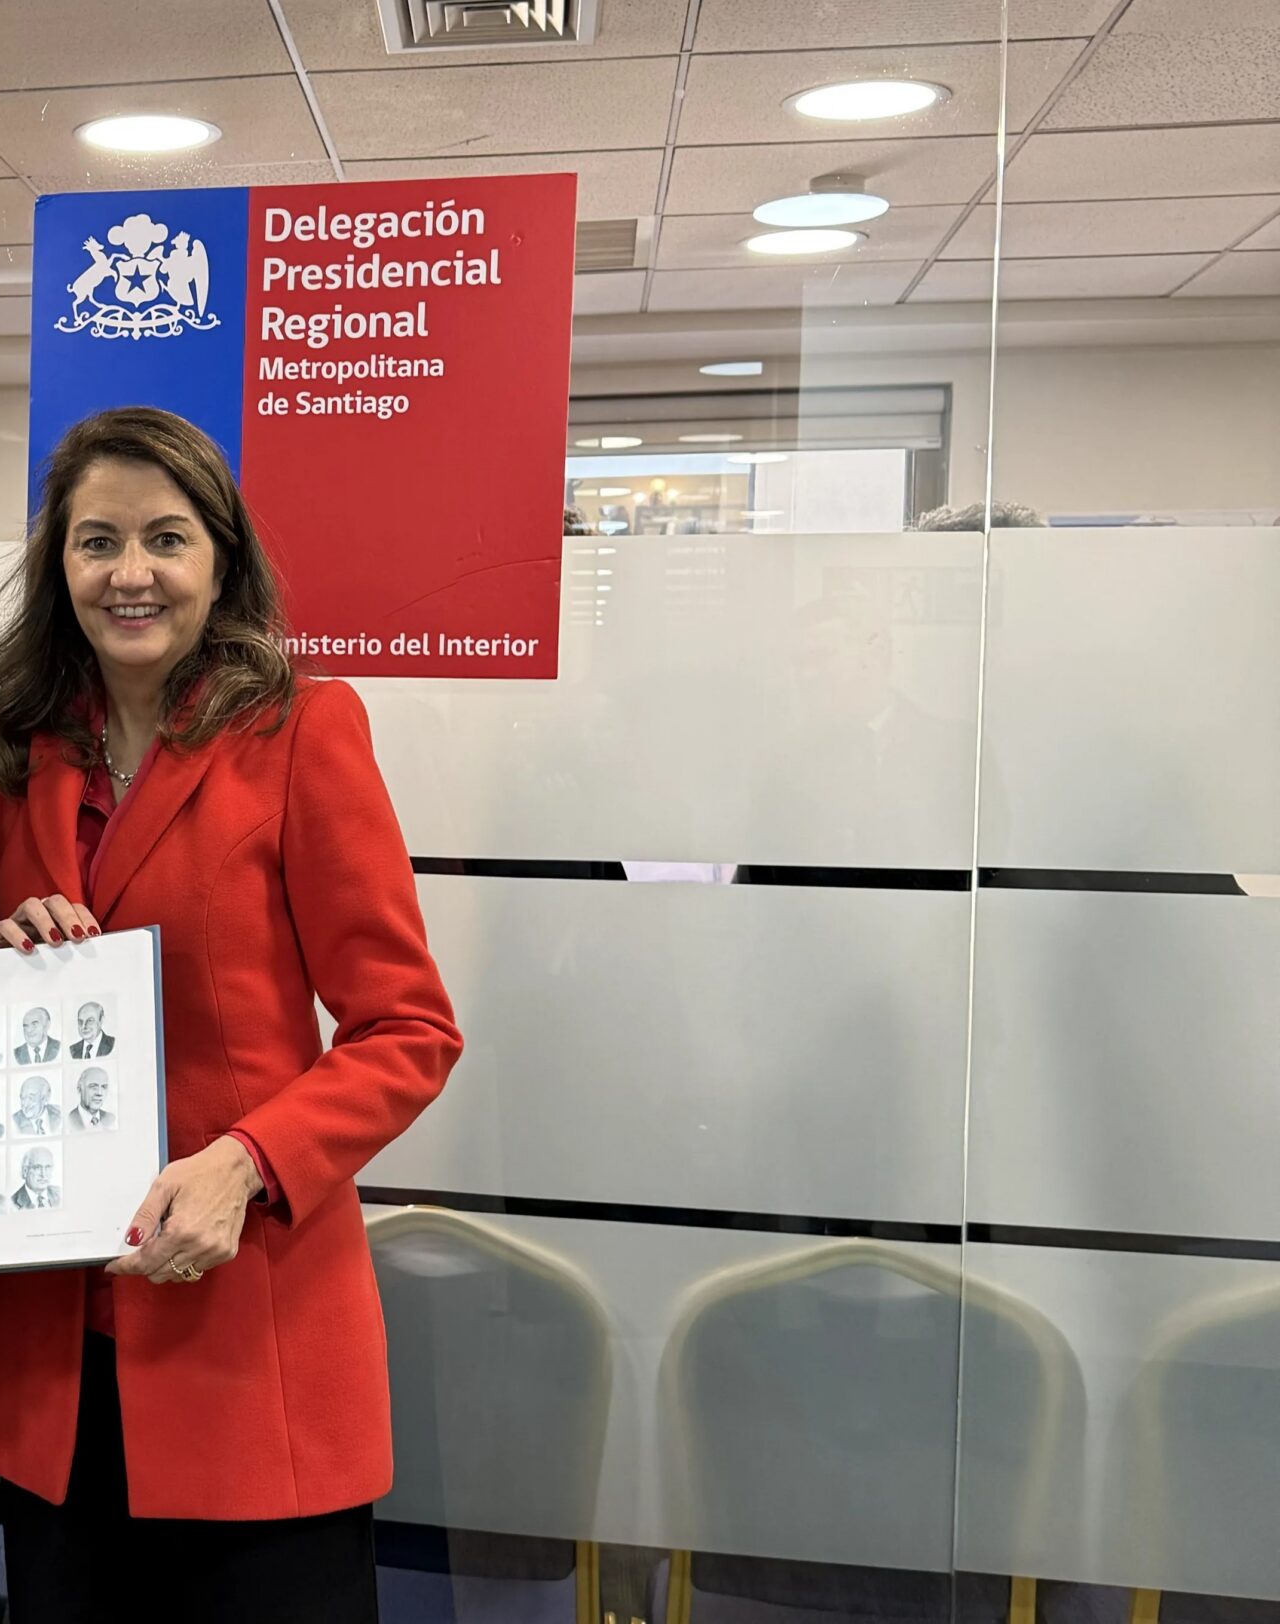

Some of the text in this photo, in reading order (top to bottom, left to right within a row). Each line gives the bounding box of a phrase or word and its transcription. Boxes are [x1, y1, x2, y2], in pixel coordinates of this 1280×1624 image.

[265, 199, 485, 248] Delegación
[263, 248, 502, 292] Presidencial
[261, 301, 429, 349] Regional
[258, 354, 444, 385] Metropolitana
[258, 390, 410, 420] de Santiago
[273, 632, 539, 657] nisterio del Interior
